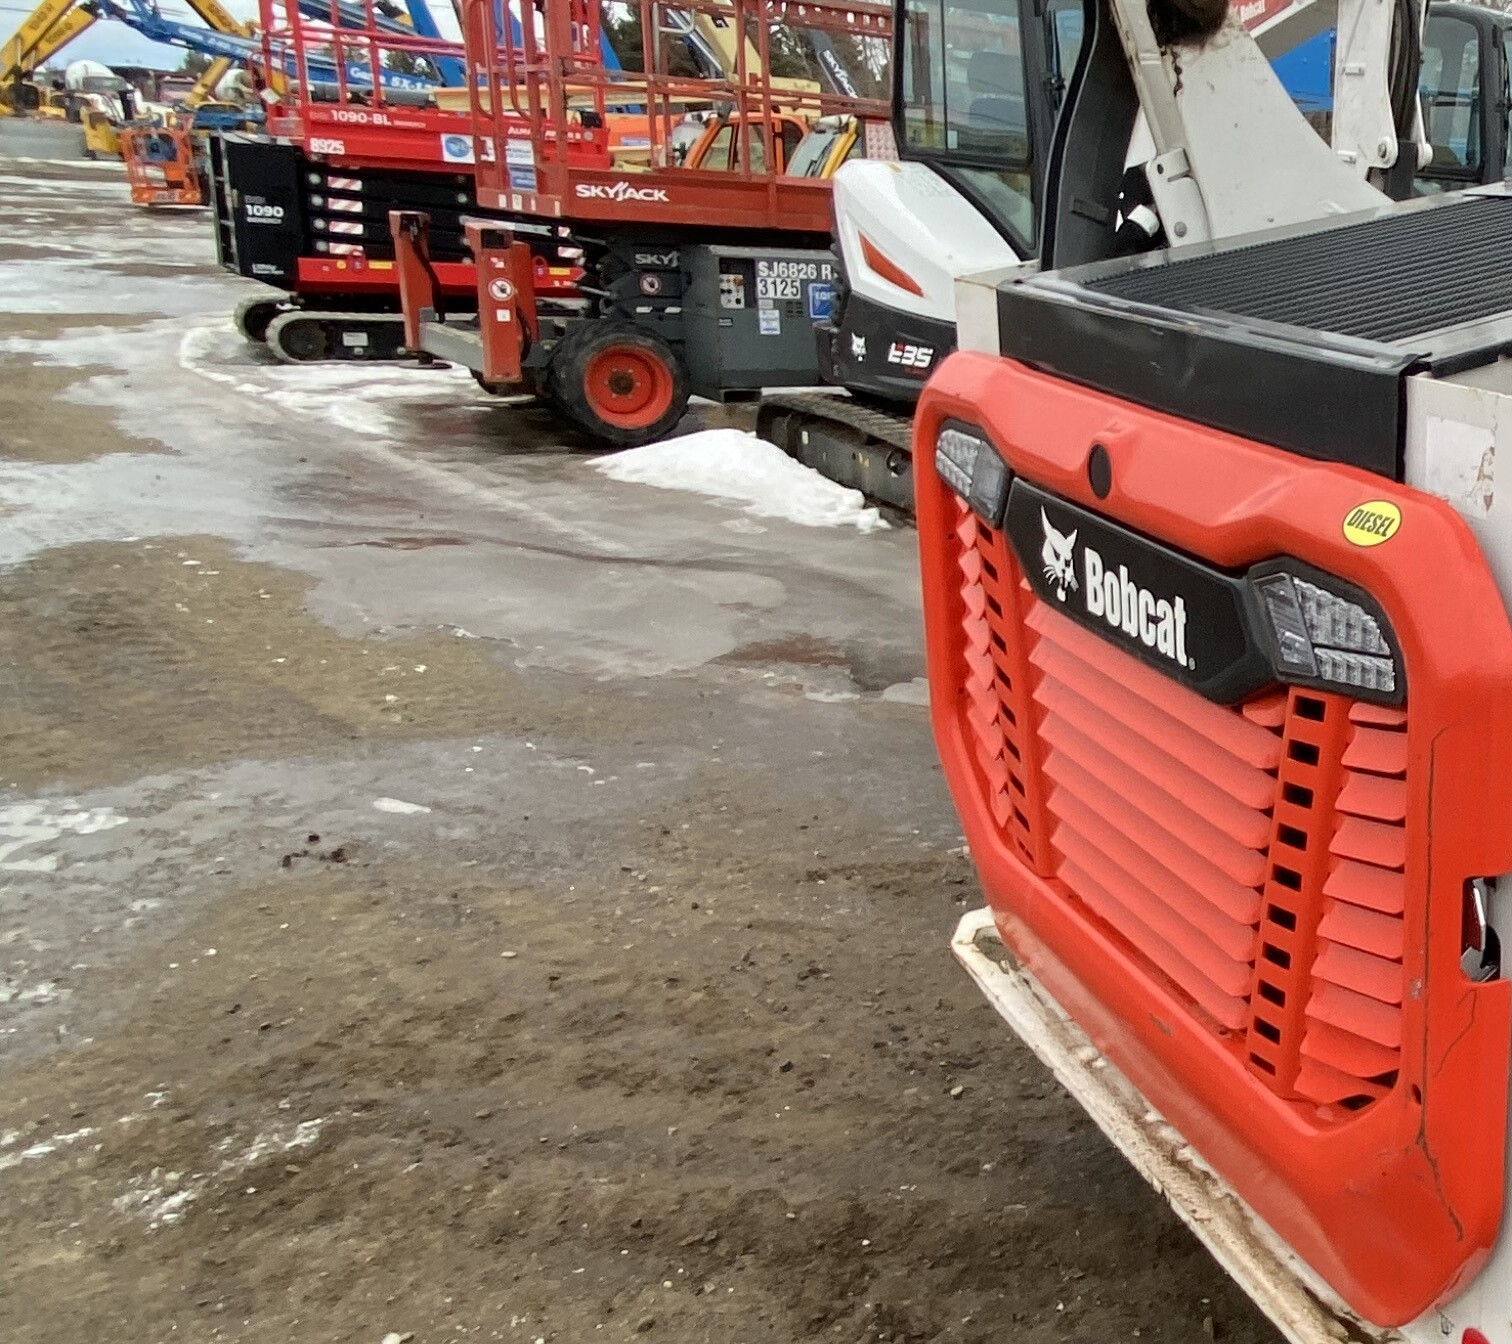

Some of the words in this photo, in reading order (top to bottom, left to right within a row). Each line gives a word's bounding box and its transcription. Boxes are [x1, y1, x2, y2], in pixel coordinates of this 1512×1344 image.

[330, 109, 392, 126] 1090-BL
[575, 181, 669, 202] SKYJACK
[245, 204, 284, 218] 1090
[758, 261, 817, 280] SJ6826
[759, 278, 800, 298] 3125
[887, 342, 934, 369] E35
[1346, 508, 1396, 538] DIESEL
[1084, 546, 1191, 671] Bobcat
